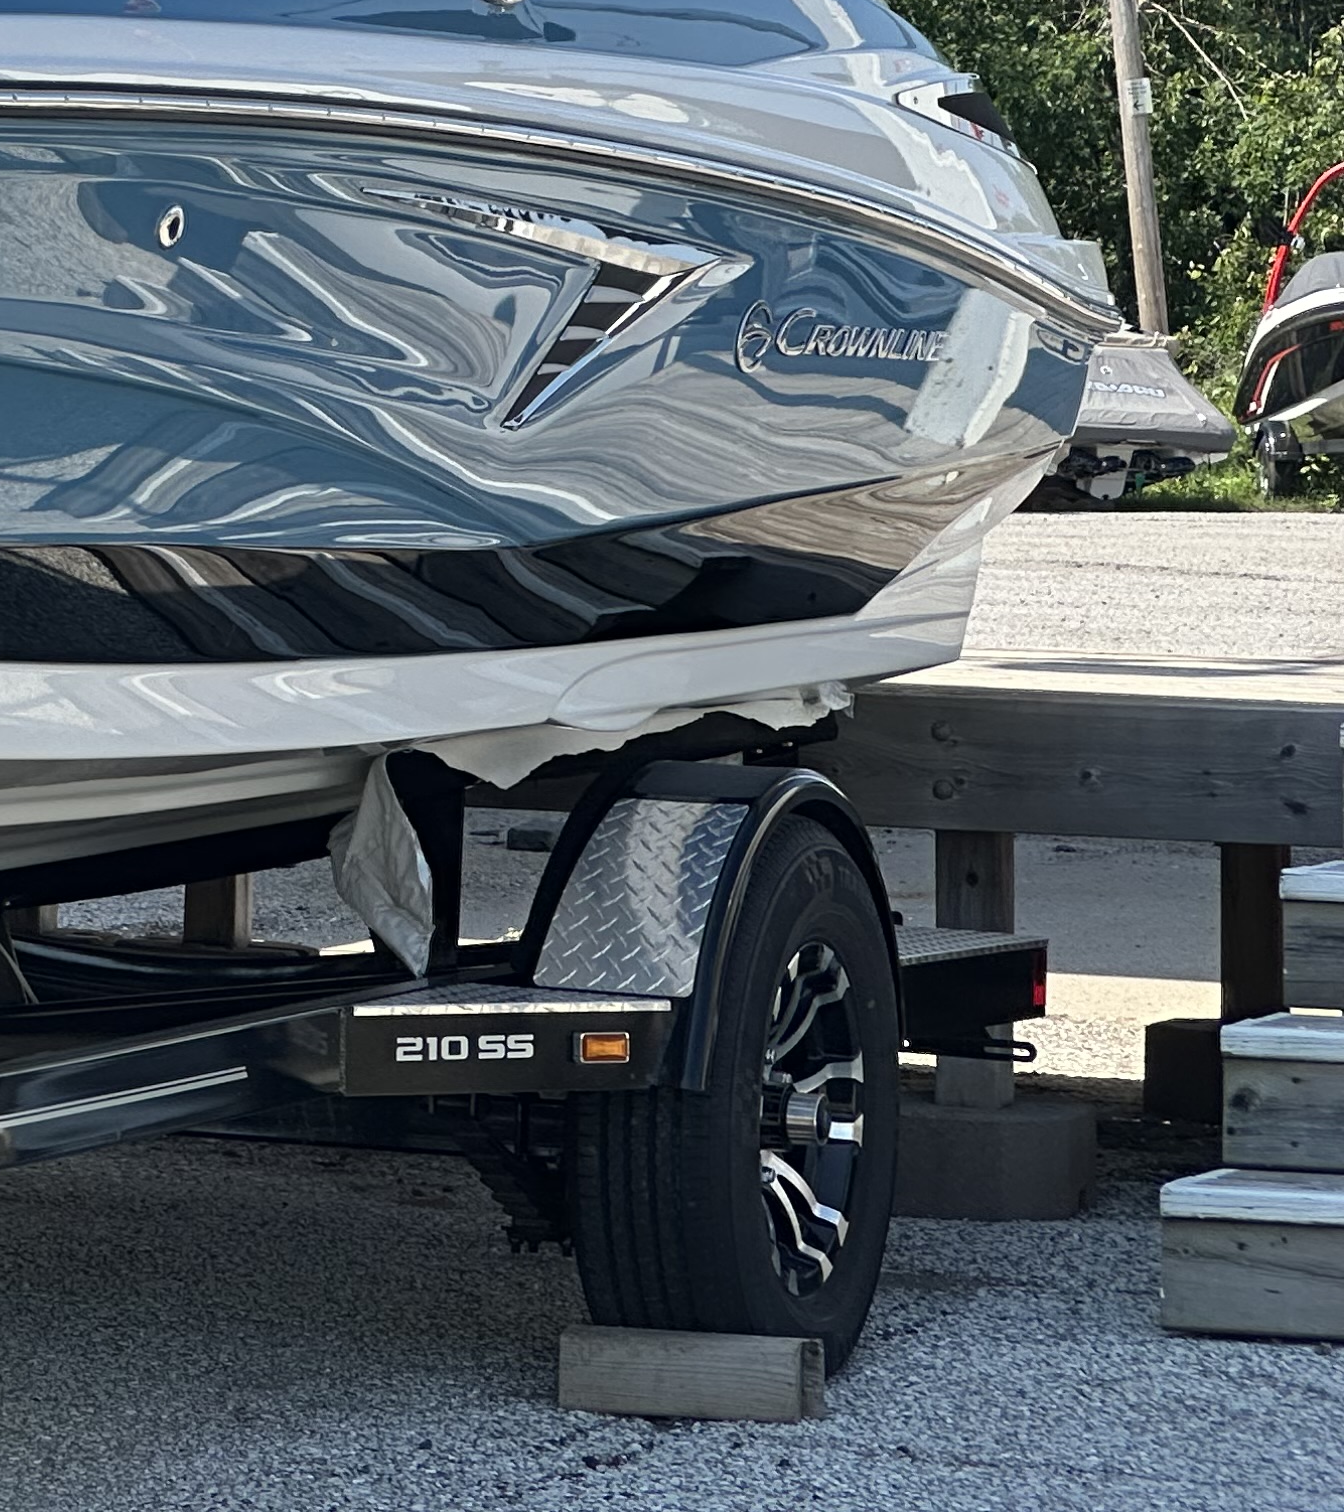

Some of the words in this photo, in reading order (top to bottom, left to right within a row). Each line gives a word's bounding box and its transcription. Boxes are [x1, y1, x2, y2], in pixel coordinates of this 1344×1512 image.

[776, 307, 950, 363] CROWNLINE
[396, 1036, 469, 1061] 210
[478, 1034, 534, 1059] SS
